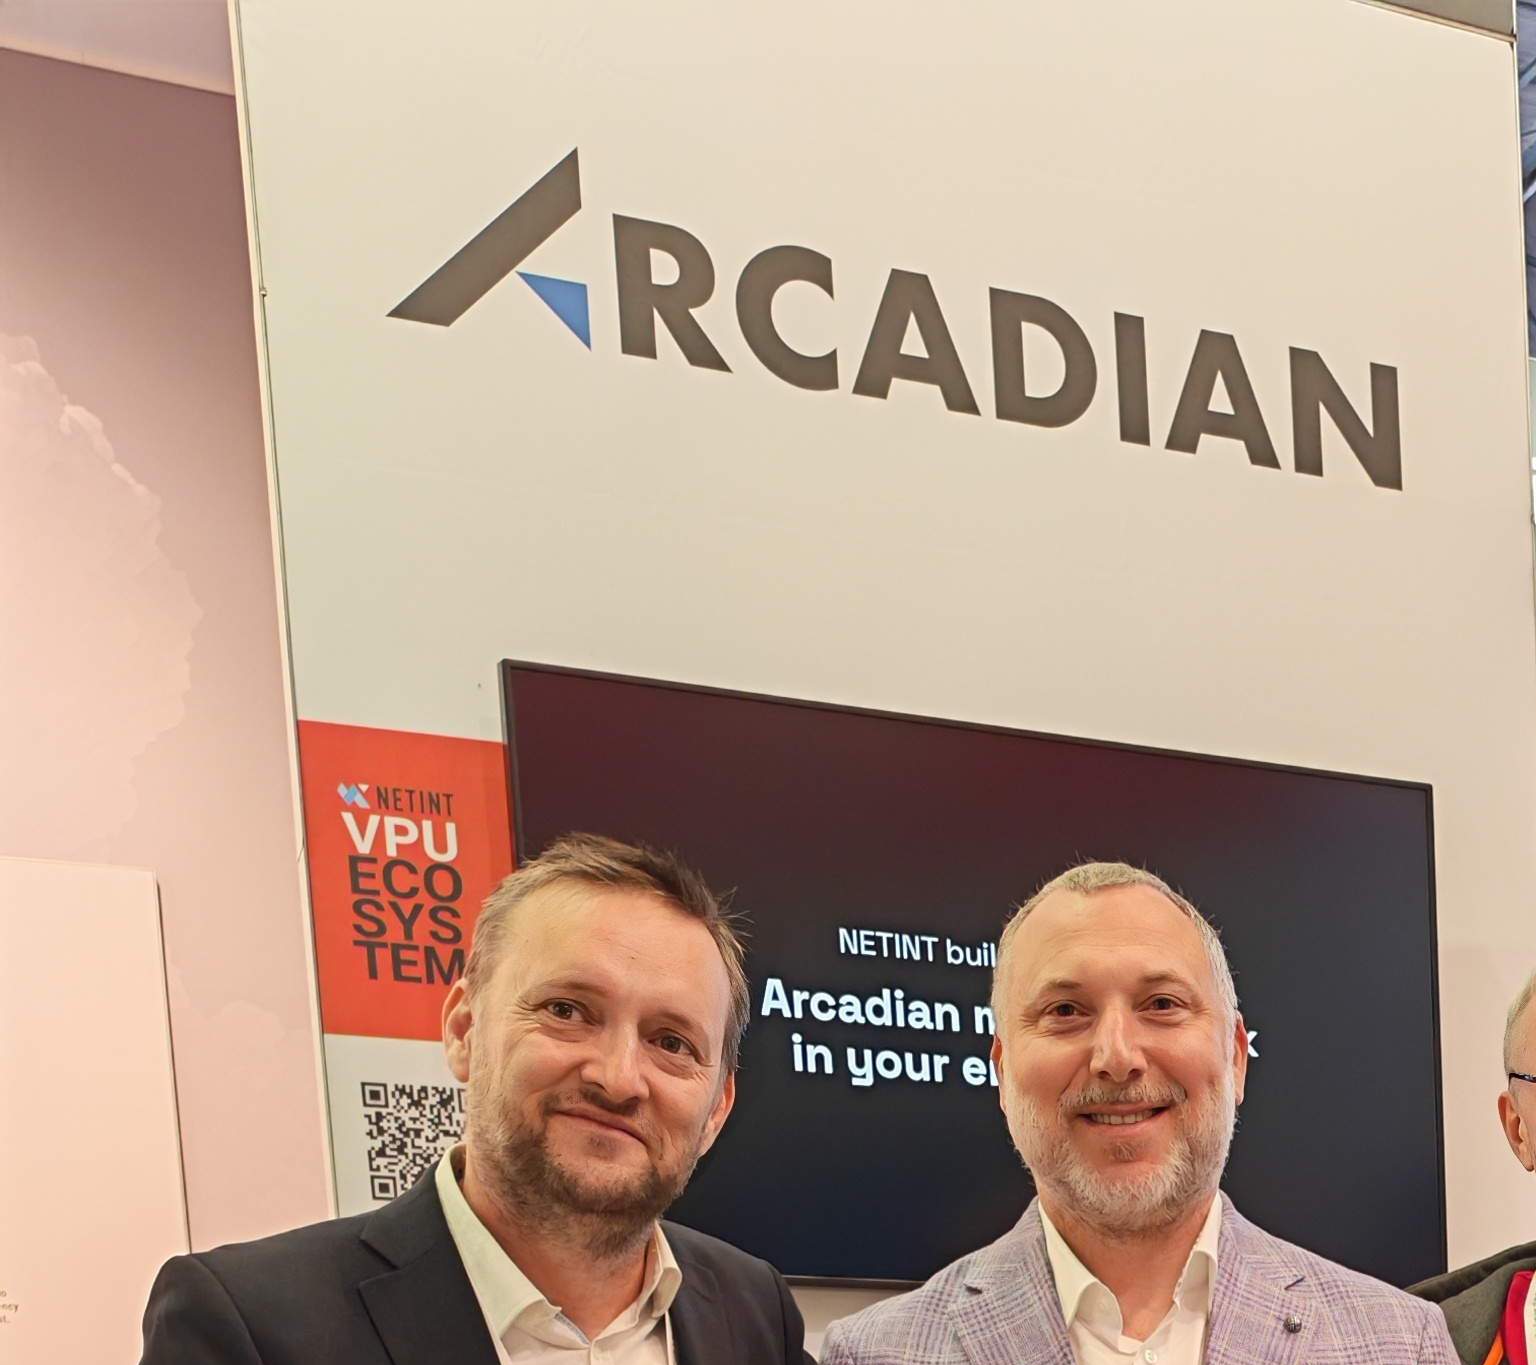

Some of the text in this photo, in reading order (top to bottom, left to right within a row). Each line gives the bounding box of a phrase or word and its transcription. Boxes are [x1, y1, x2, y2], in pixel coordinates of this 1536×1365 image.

[376, 785, 454, 817] NETINT
[341, 811, 458, 862] VPU
[348, 855, 462, 903] ECO
[352, 898, 462, 944] SYS
[353, 940, 466, 986] TEM
[838, 928, 939, 962] NETINT
[761, 978, 961, 1034] Arcadian
[791, 1034, 833, 1075] in
[846, 1041, 950, 1088] your
